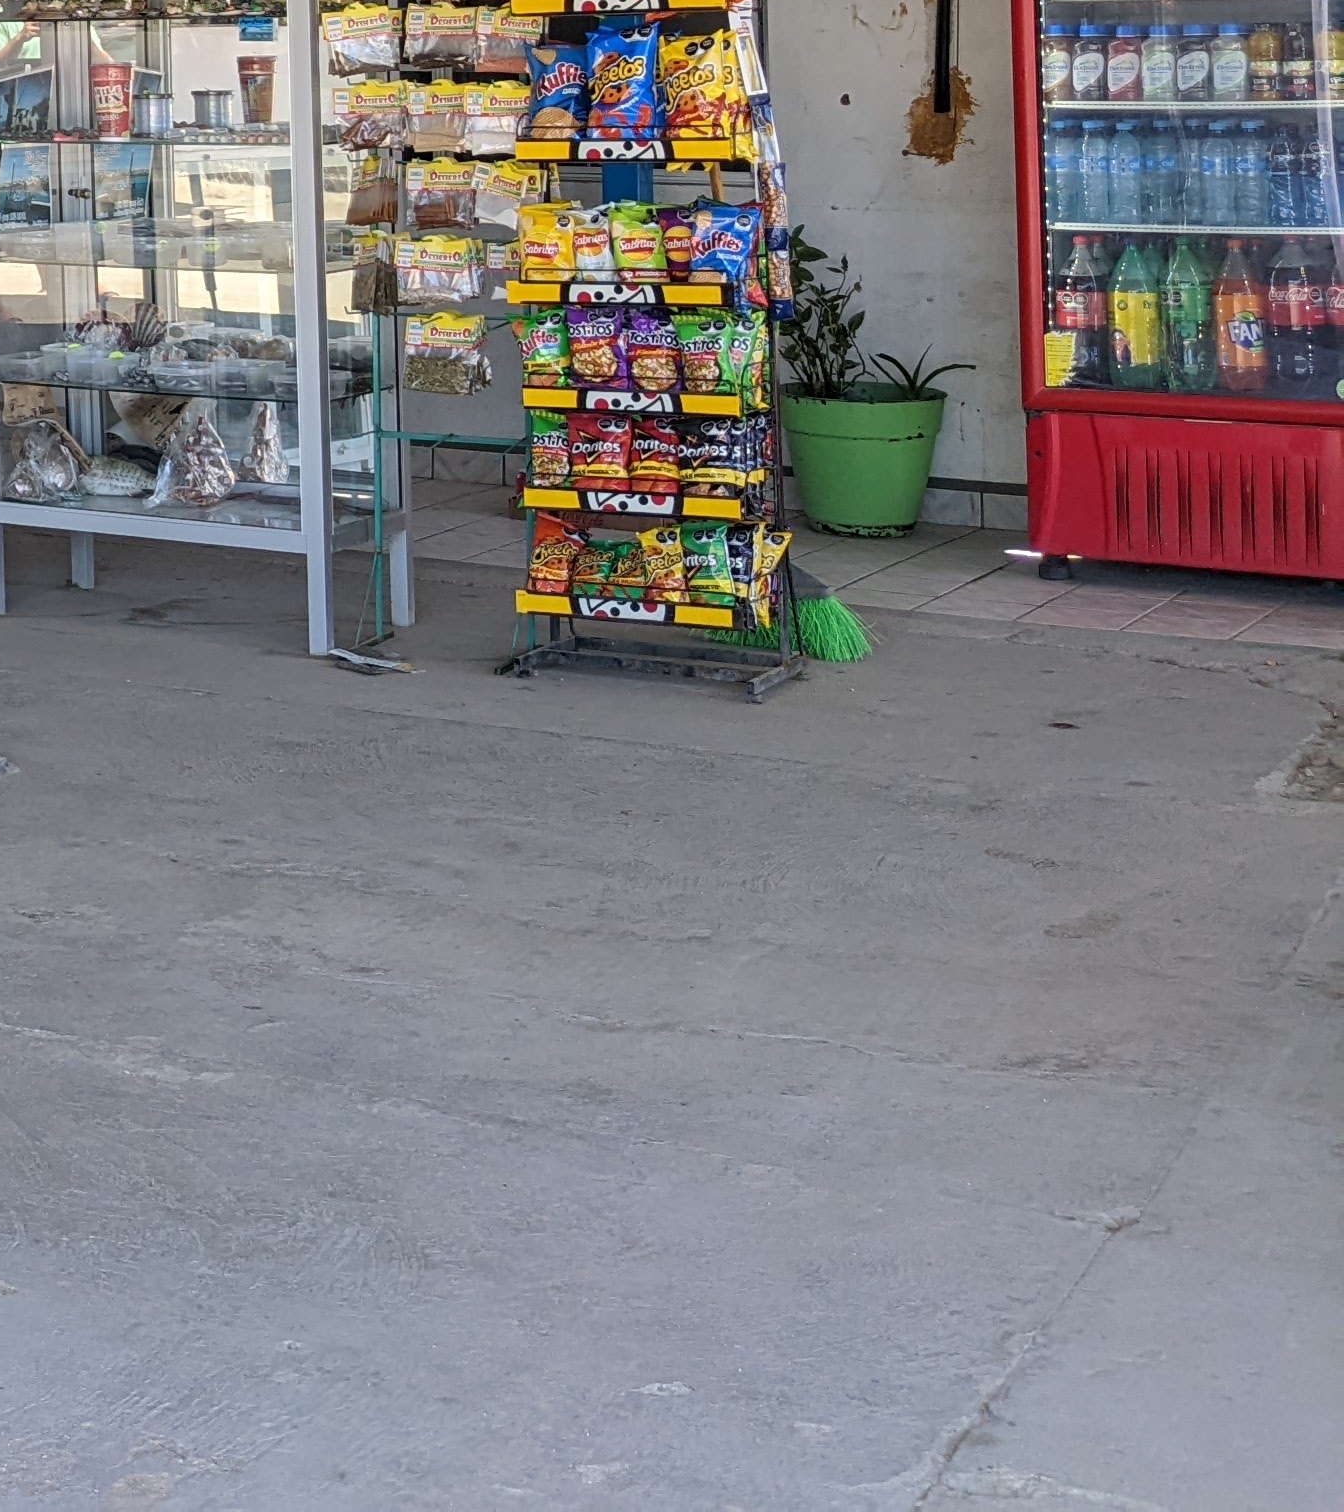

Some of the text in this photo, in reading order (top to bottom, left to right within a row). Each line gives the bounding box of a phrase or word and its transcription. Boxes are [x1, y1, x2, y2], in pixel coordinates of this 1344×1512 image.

[537, 62, 587, 101] Ruffle
[620, 239, 657, 252] Sabritas
[663, 238, 691, 250] Sabrit
[1229, 321, 1262, 342] FAN
[571, 441, 621, 455] Doritos
[678, 443, 732, 457] Doritos
